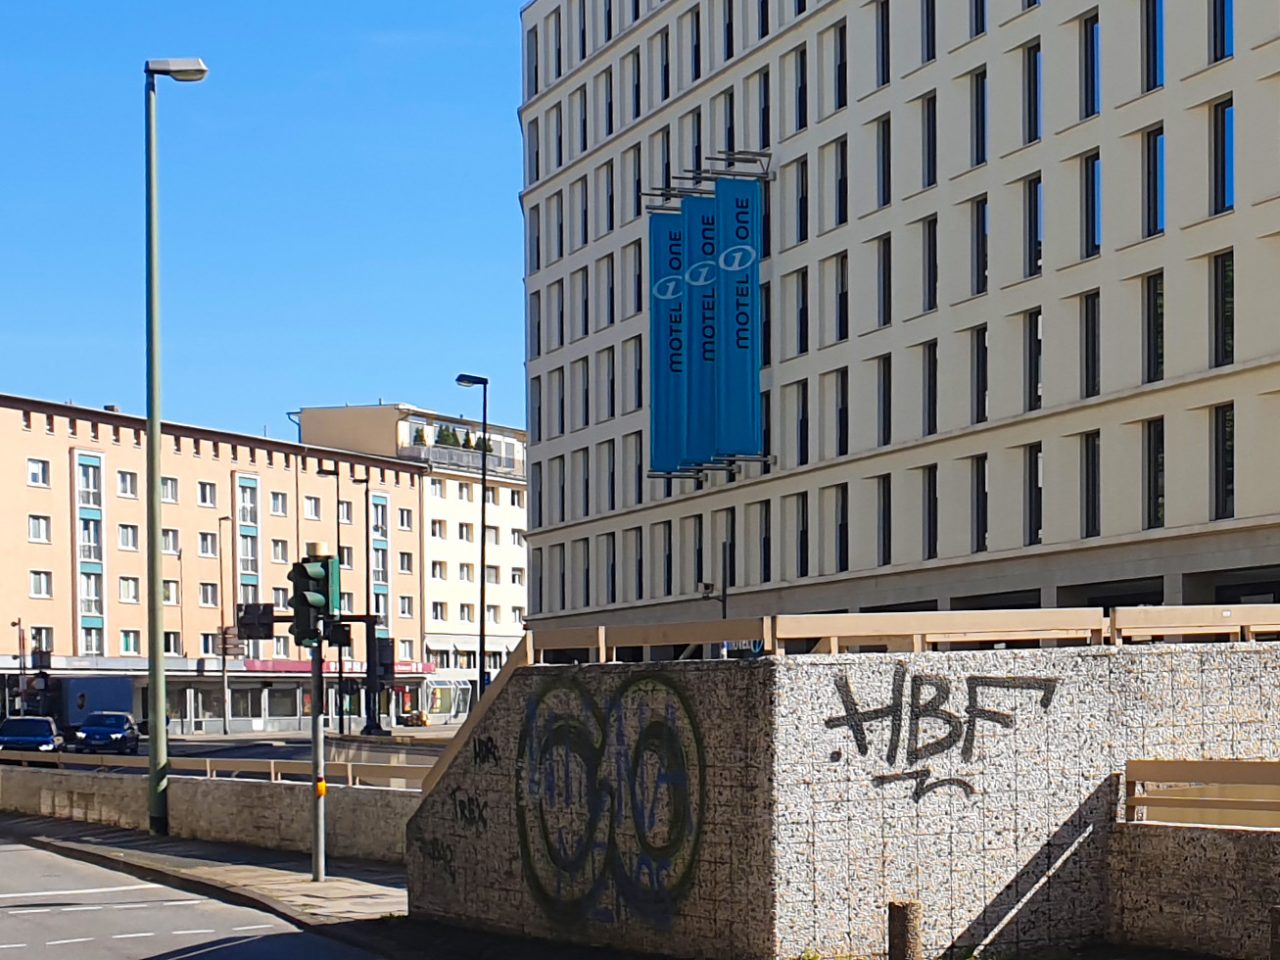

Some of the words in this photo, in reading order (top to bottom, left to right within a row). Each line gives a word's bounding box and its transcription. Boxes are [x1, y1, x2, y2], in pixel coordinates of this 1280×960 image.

[669, 231, 682, 270] ONE
[702, 215, 715, 256] ONE
[735, 197, 749, 240] ONE
[669, 302, 682, 372] MOTEL
[703, 288, 716, 362] MOTEL
[736, 274, 749, 349] MOTEL
[825, 659, 1062, 766] HBF
